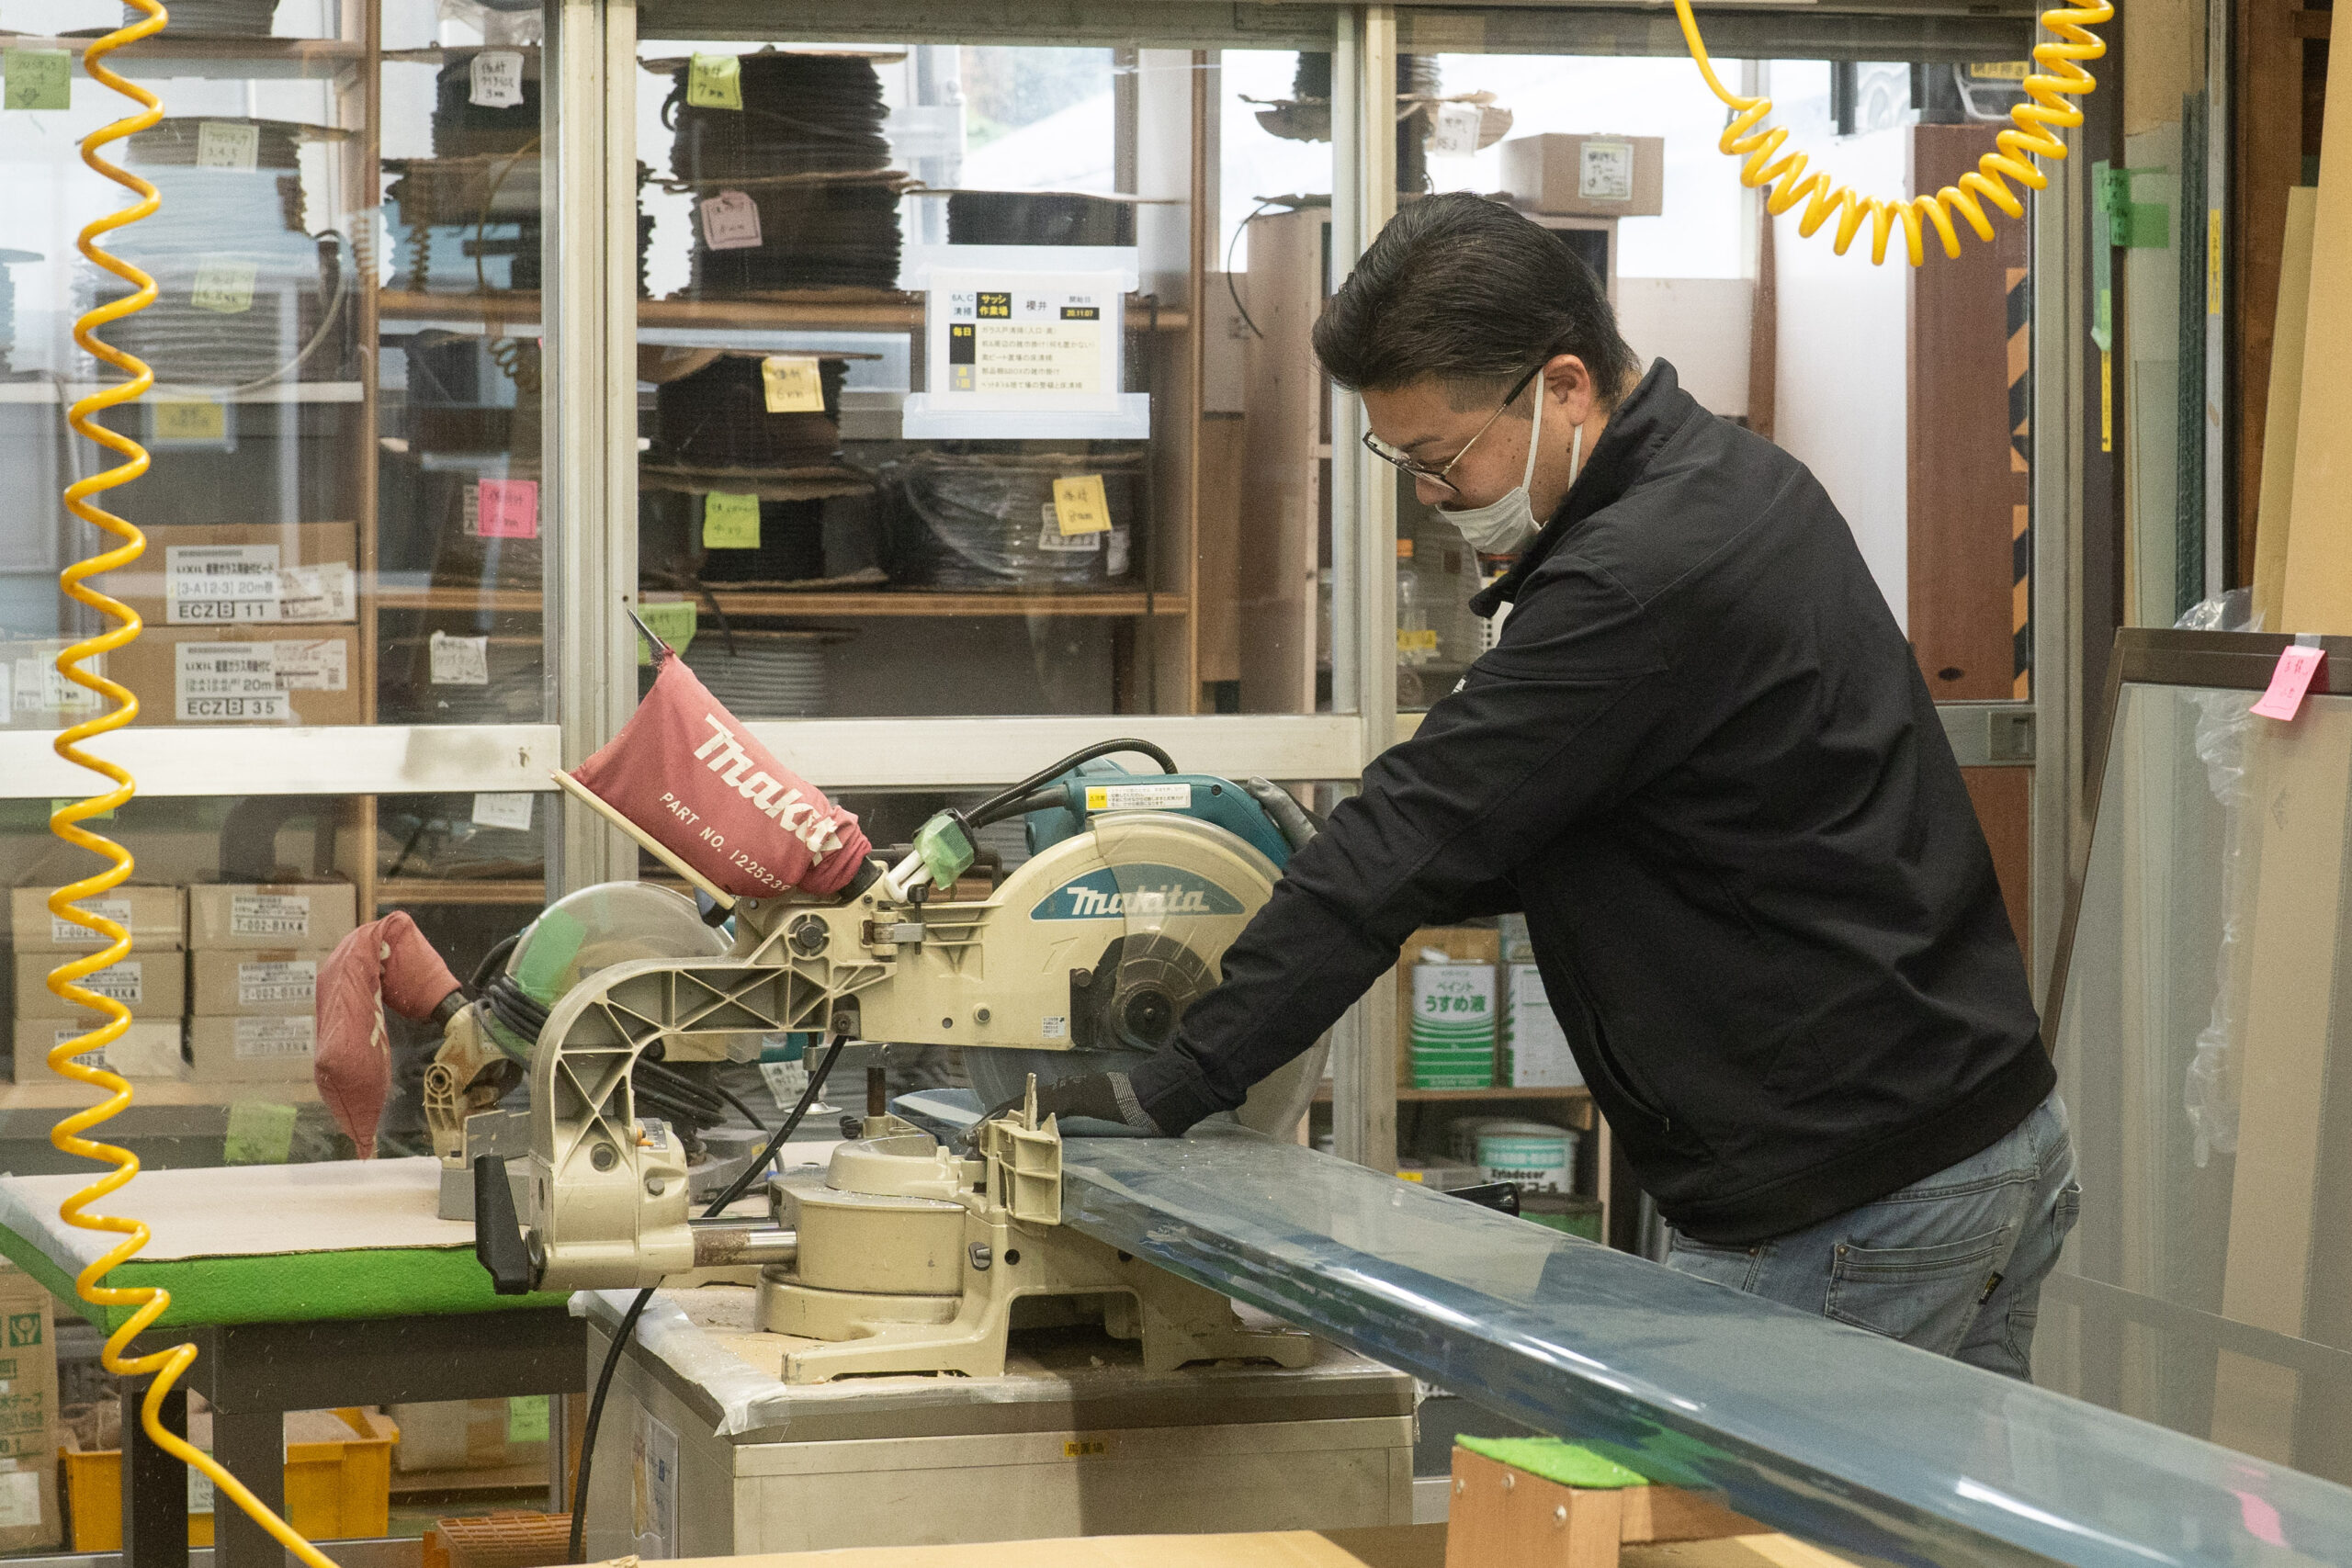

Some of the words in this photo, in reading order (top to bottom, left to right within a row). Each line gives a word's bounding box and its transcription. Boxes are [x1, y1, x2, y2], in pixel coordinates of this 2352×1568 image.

[980, 294, 1007, 304] サッシ
[979, 306, 1009, 316] 作業場
[953, 327, 972, 336] 毎日
[659, 792, 700, 826] PART
[699, 826, 725, 852] NO.
[1425, 994, 1487, 1013] うすめ液
